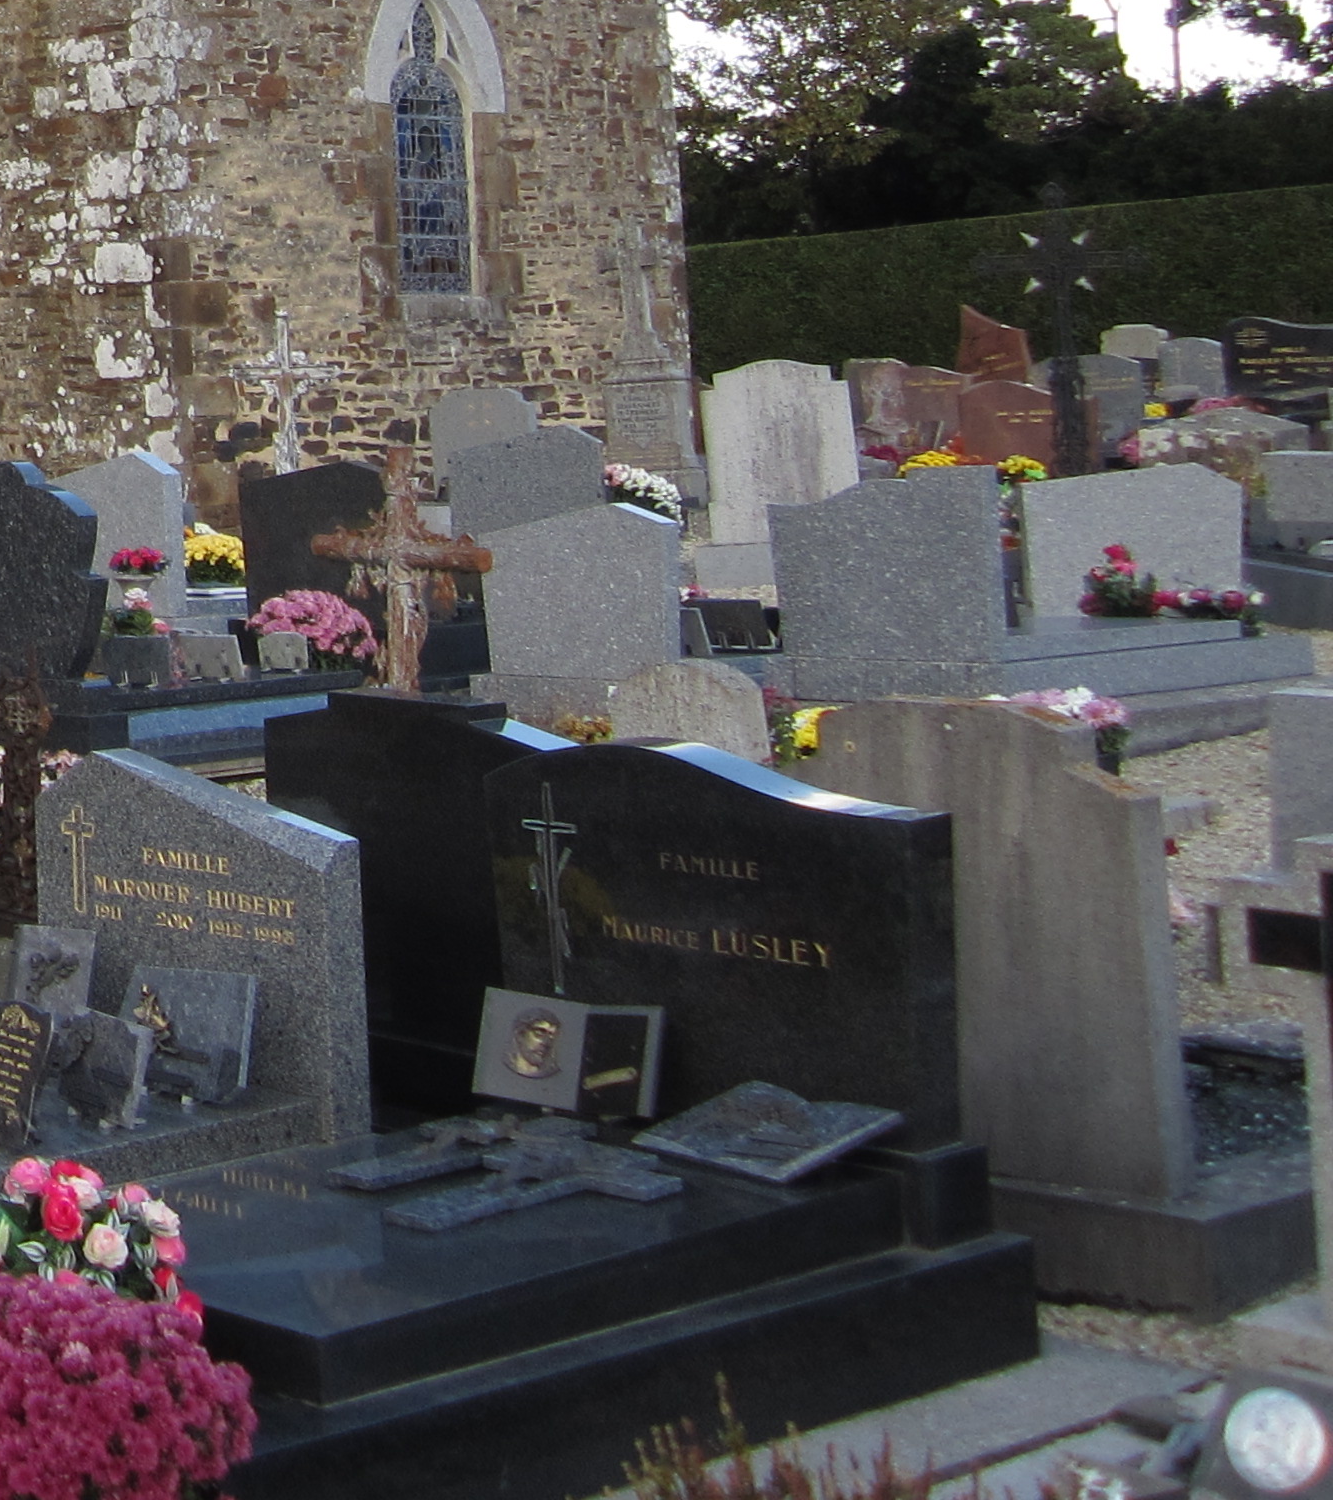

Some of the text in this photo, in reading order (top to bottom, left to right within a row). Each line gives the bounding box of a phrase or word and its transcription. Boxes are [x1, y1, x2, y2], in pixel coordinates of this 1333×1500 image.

[142, 846, 230, 875] FAMILLE
[659, 852, 760, 882] FAMILLE
[93, 875, 190, 904] MARQUER
[207, 889, 296, 919] HUBERT
[155, 911, 194, 931] 2010
[601, 914, 832, 969] MAURICE LUSLEY
